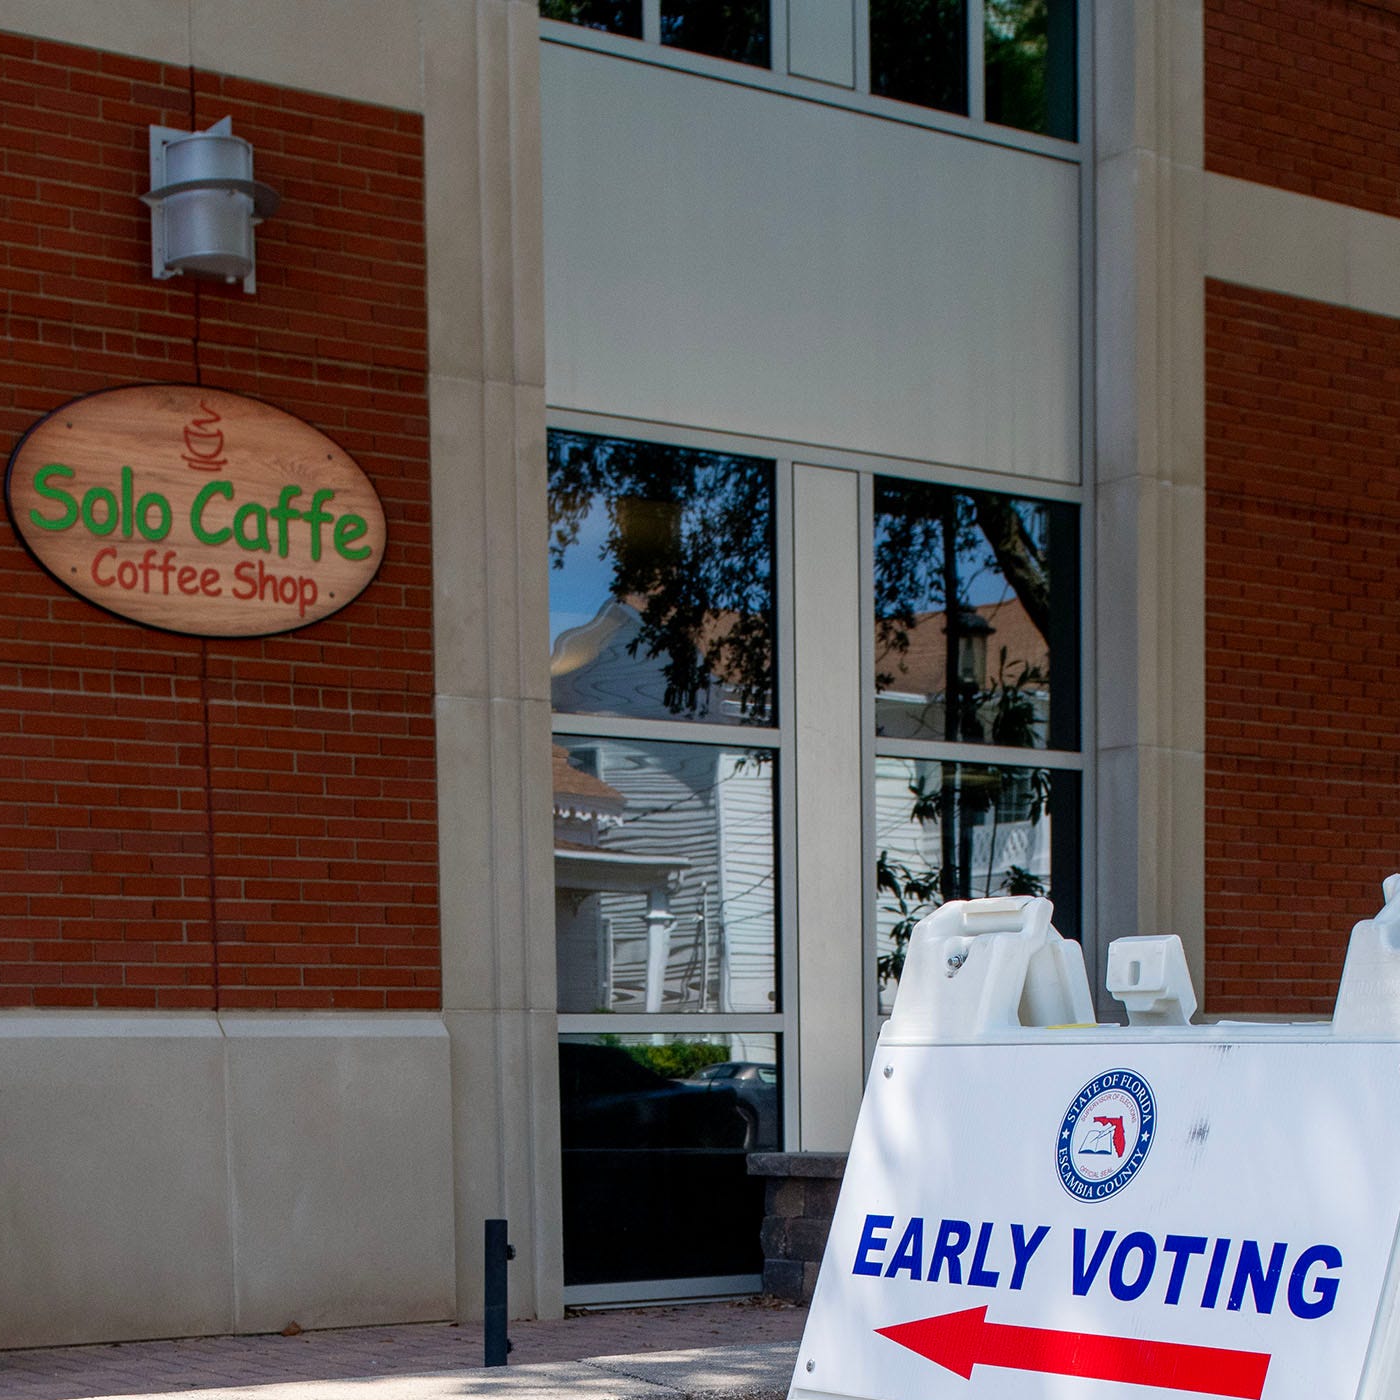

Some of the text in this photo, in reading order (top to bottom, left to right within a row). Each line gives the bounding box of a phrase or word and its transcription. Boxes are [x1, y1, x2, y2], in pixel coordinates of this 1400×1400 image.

[30, 464, 372, 561] Solo Caffe
[91, 546, 318, 617] Coffee Shop
[1067, 1074, 1152, 1124] STATE OF FLORIDA
[1081, 1093, 1111, 1122] SUPERVISOR
[1120, 1095, 1137, 1123] ELECTIONS
[1059, 1147, 1144, 1197] ESCAMBIA COUNTY
[1080, 1165, 1113, 1178] OFFICIAL SEAL
[852, 1214, 1343, 1319] EARLY VOTING
